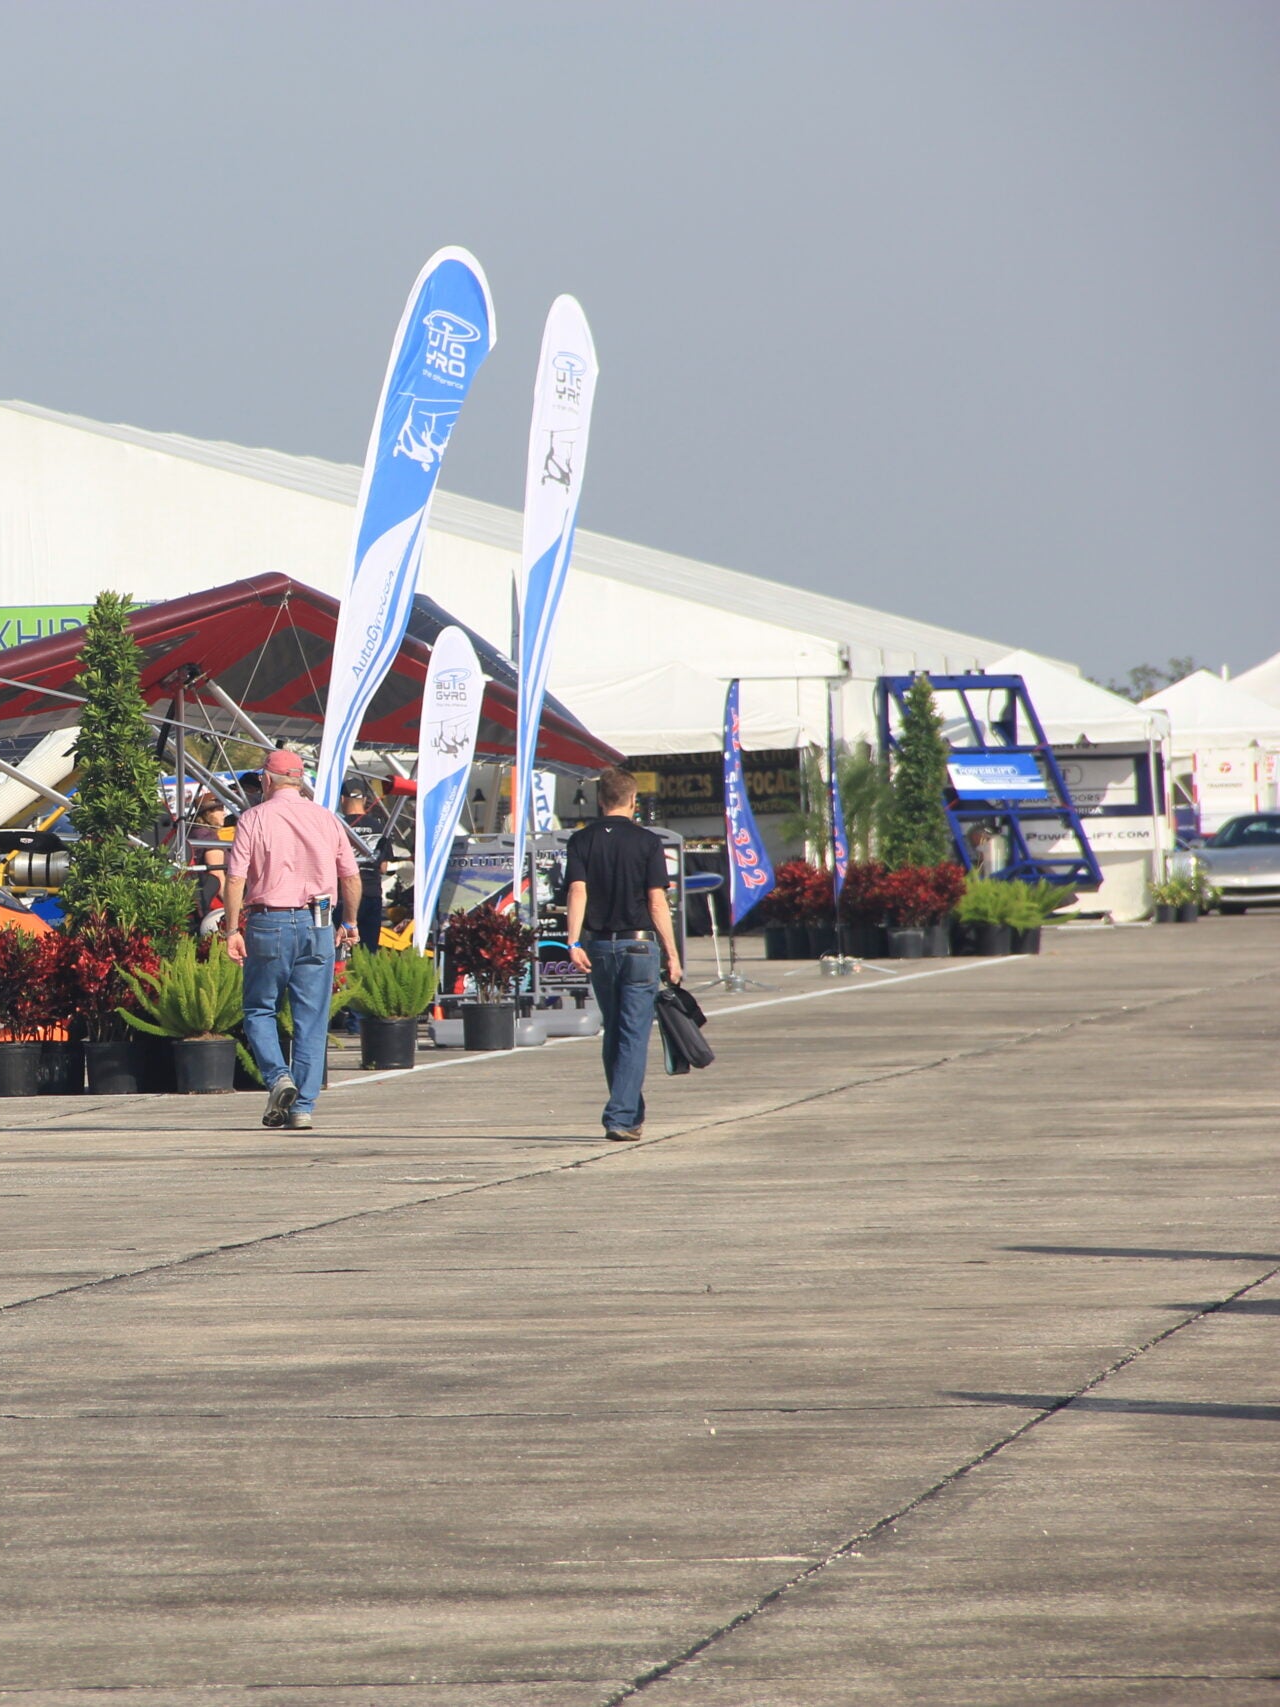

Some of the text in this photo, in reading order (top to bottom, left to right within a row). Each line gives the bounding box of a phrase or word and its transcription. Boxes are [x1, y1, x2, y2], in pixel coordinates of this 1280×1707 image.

[425, 350, 466, 378] YRO
[435, 690, 467, 701] GYRO
[1025, 831, 1150, 842] POWEIFT.COM
